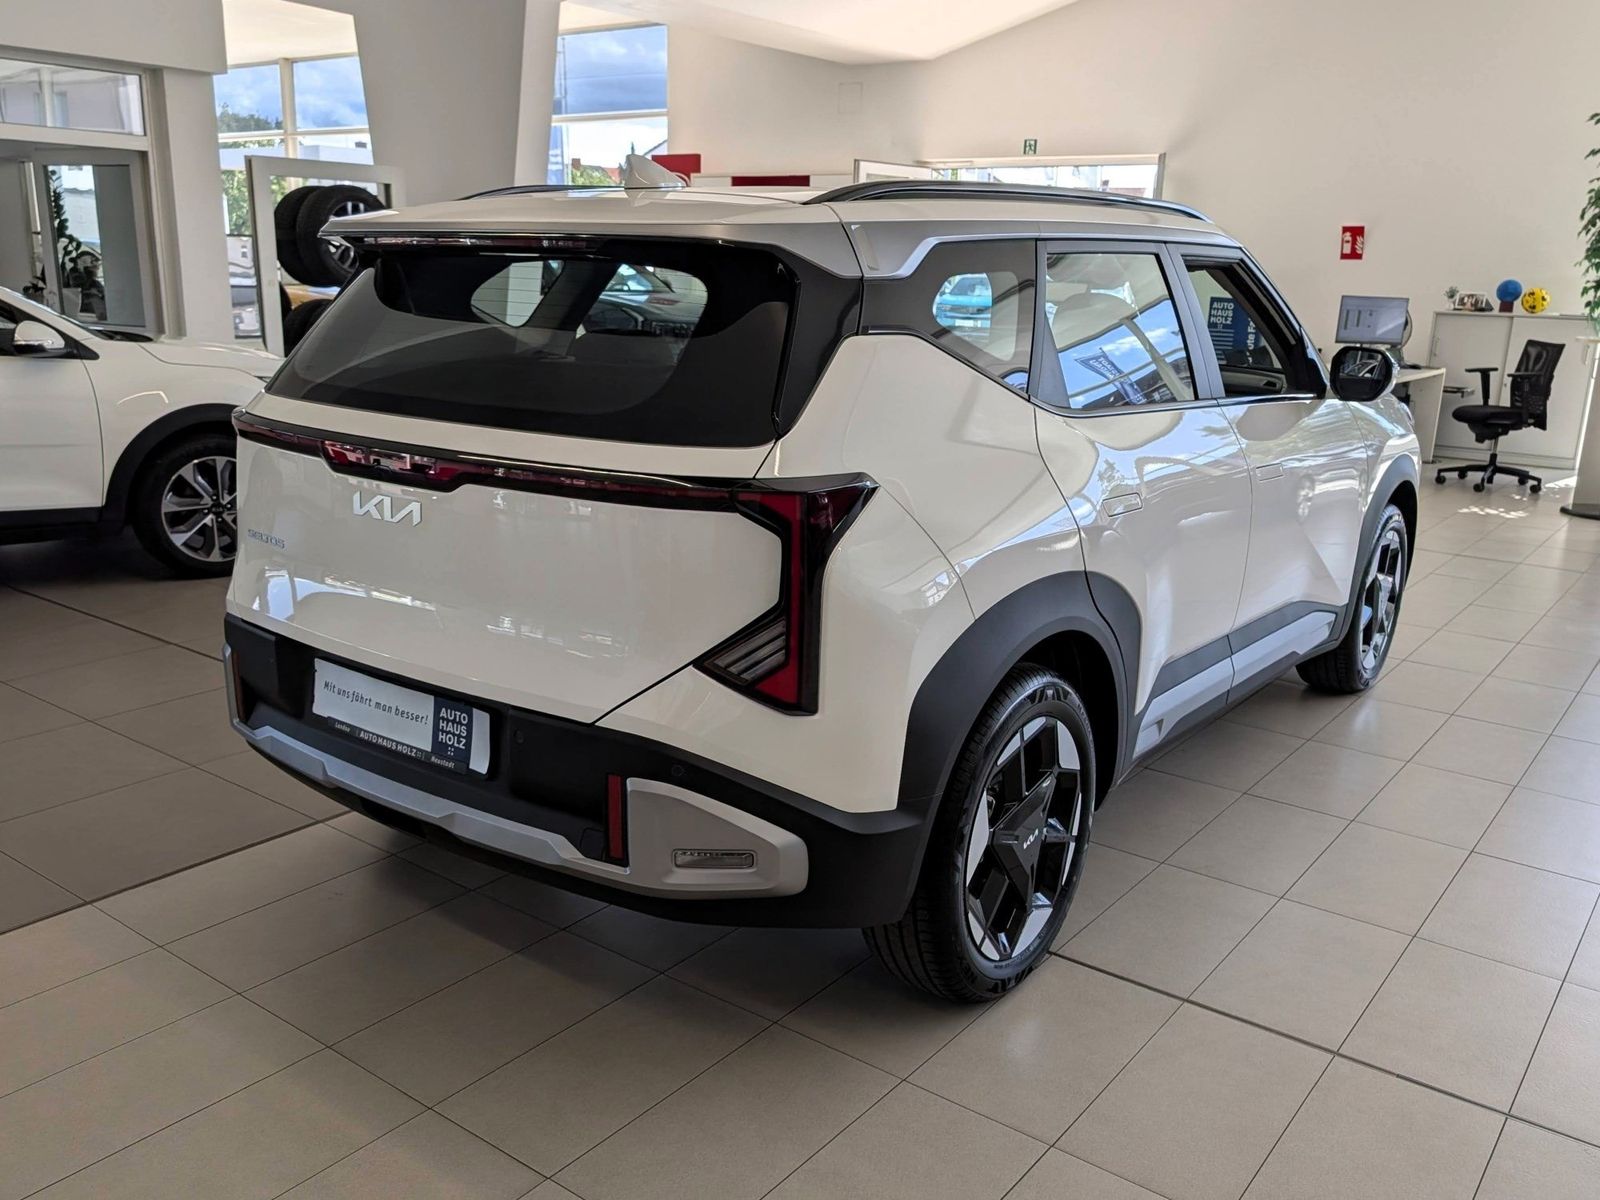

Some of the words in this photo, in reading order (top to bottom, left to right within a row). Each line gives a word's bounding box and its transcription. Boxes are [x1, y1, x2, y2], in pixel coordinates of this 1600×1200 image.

[1211, 309, 1233, 317] HAUS
[1212, 301, 1234, 309] AUTO
[1210, 316, 1232, 325] HOLZ
[352, 490, 422, 527] KIA
[323, 680, 336, 693] Mit
[337, 688, 350, 699] uns
[374, 701, 393, 714] man
[394, 705, 429, 725] besser!
[439, 707, 469, 724] AUTO
[439, 719, 467, 737] HAUS
[438, 731, 467, 750] HOLZ
[397, 744, 417, 757] HOLZ
[1023, 828, 1039, 850] KIA
